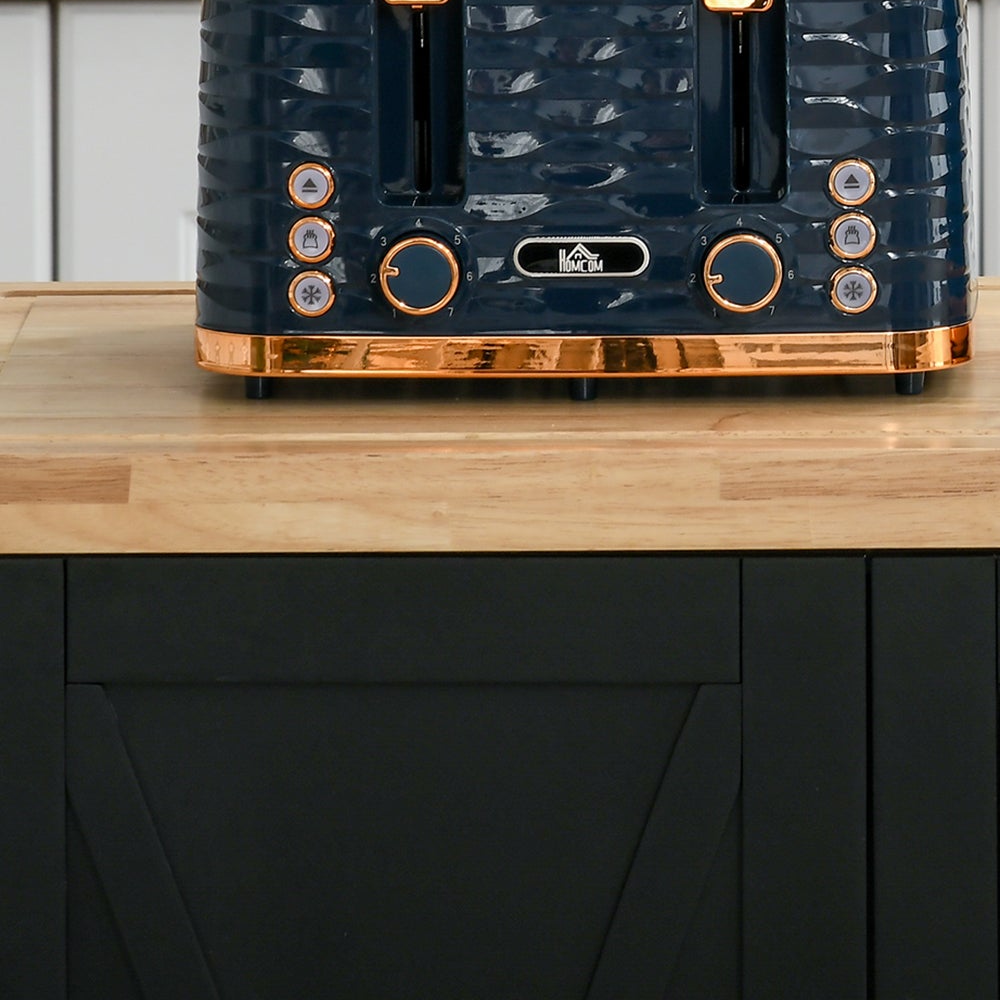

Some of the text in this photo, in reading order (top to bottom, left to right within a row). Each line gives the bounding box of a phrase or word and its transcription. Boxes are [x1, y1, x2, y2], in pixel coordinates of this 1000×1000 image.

[380, 236, 387, 246] 3
[454, 234, 461, 245] 5
[701, 236, 707, 246] 3
[775, 233, 782, 244] 5
[370, 273, 377, 284] 2
[466, 271, 473, 282] 6
[690, 273, 696, 284] 2
[787, 270, 794, 280] 6
[447, 307, 454, 317] 7
[769, 305, 775, 316] 7
